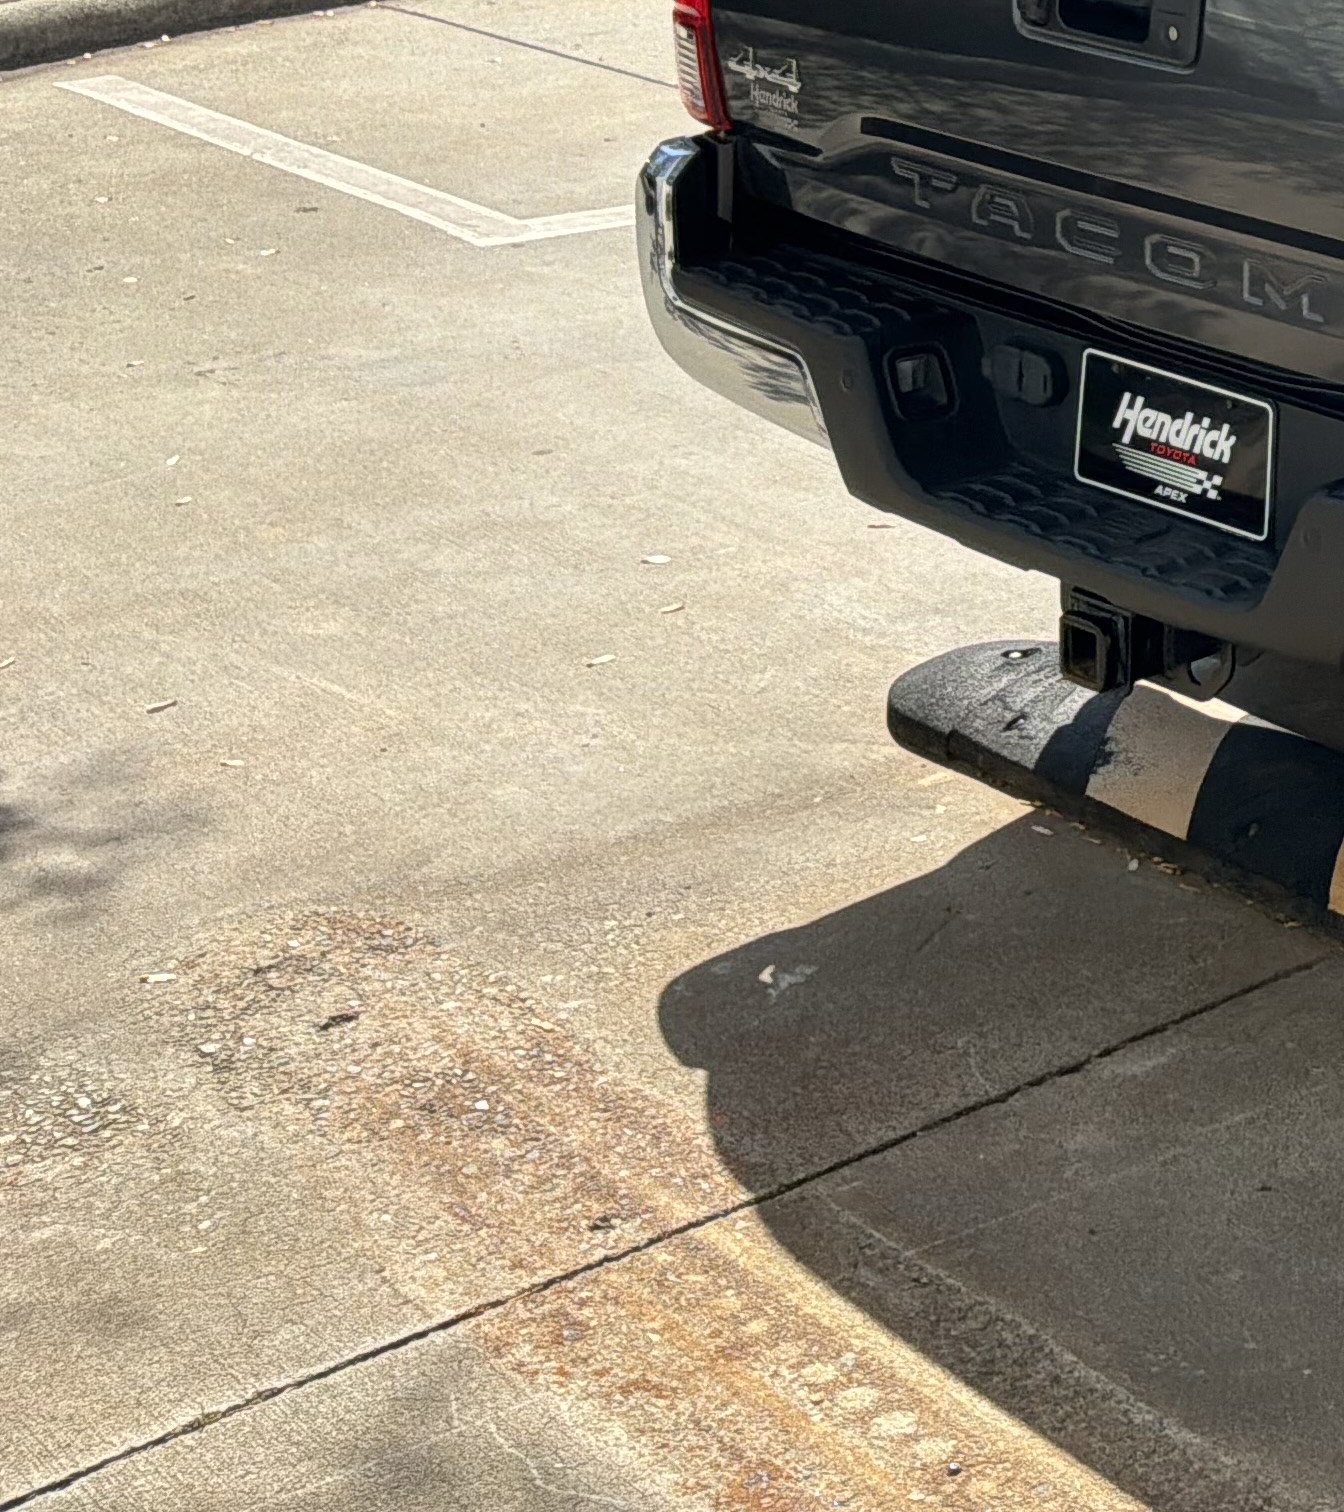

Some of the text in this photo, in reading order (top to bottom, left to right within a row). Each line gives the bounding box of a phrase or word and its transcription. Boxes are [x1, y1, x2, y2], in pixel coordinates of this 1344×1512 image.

[750, 82, 799, 114] Hendrick
[1111, 391, 1237, 464] Hendrick
[1150, 442, 1198, 466] TOYOTA
[1153, 484, 1189, 504] APEX
